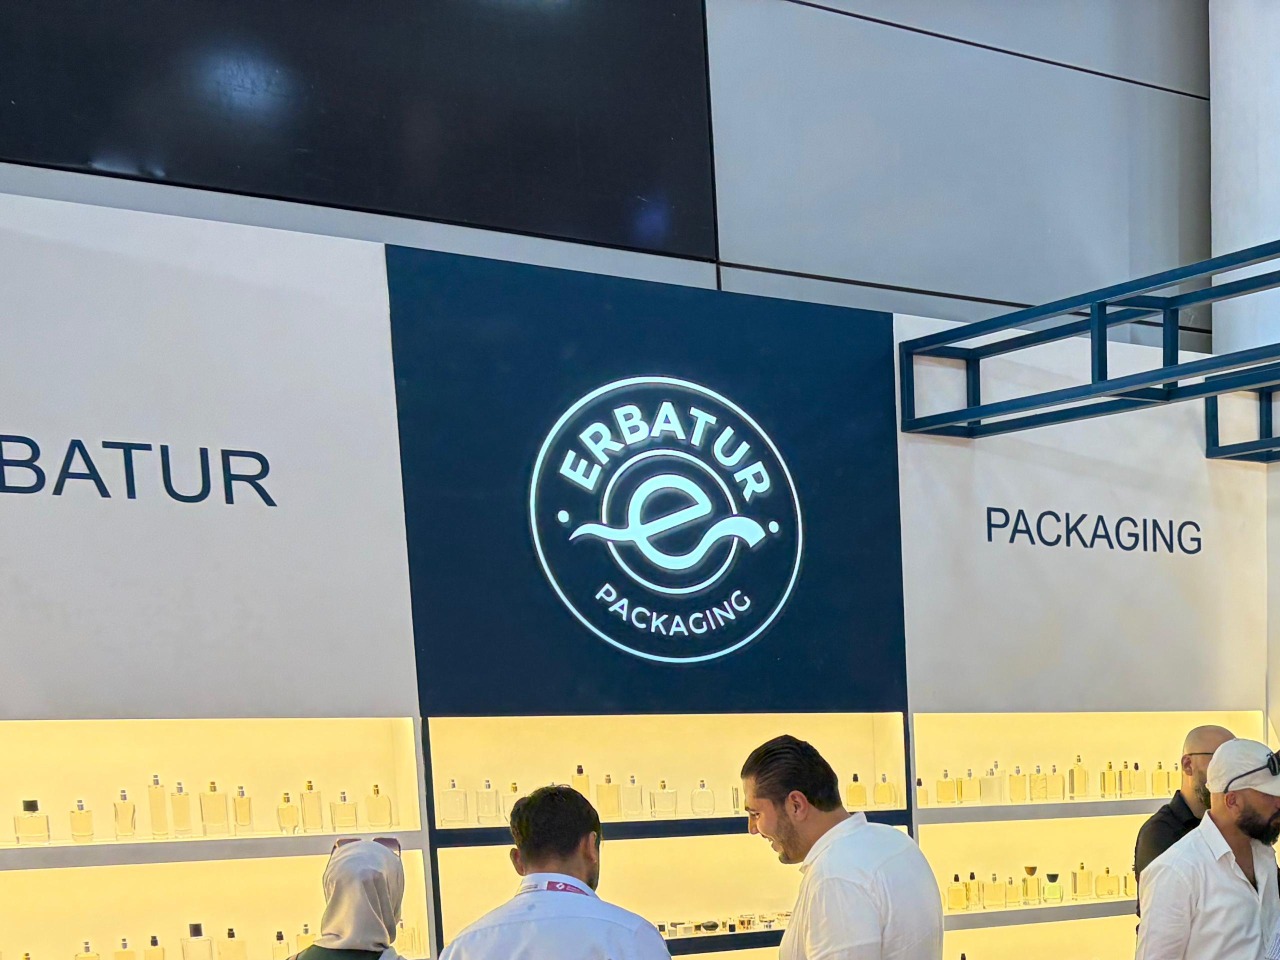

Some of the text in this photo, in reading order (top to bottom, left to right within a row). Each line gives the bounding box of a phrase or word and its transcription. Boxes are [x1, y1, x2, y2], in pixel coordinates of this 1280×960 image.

[560, 402, 771, 501] ERBATUR
[987, 506, 1202, 554] PACKAGING
[596, 583, 752, 636] PACKAGING
